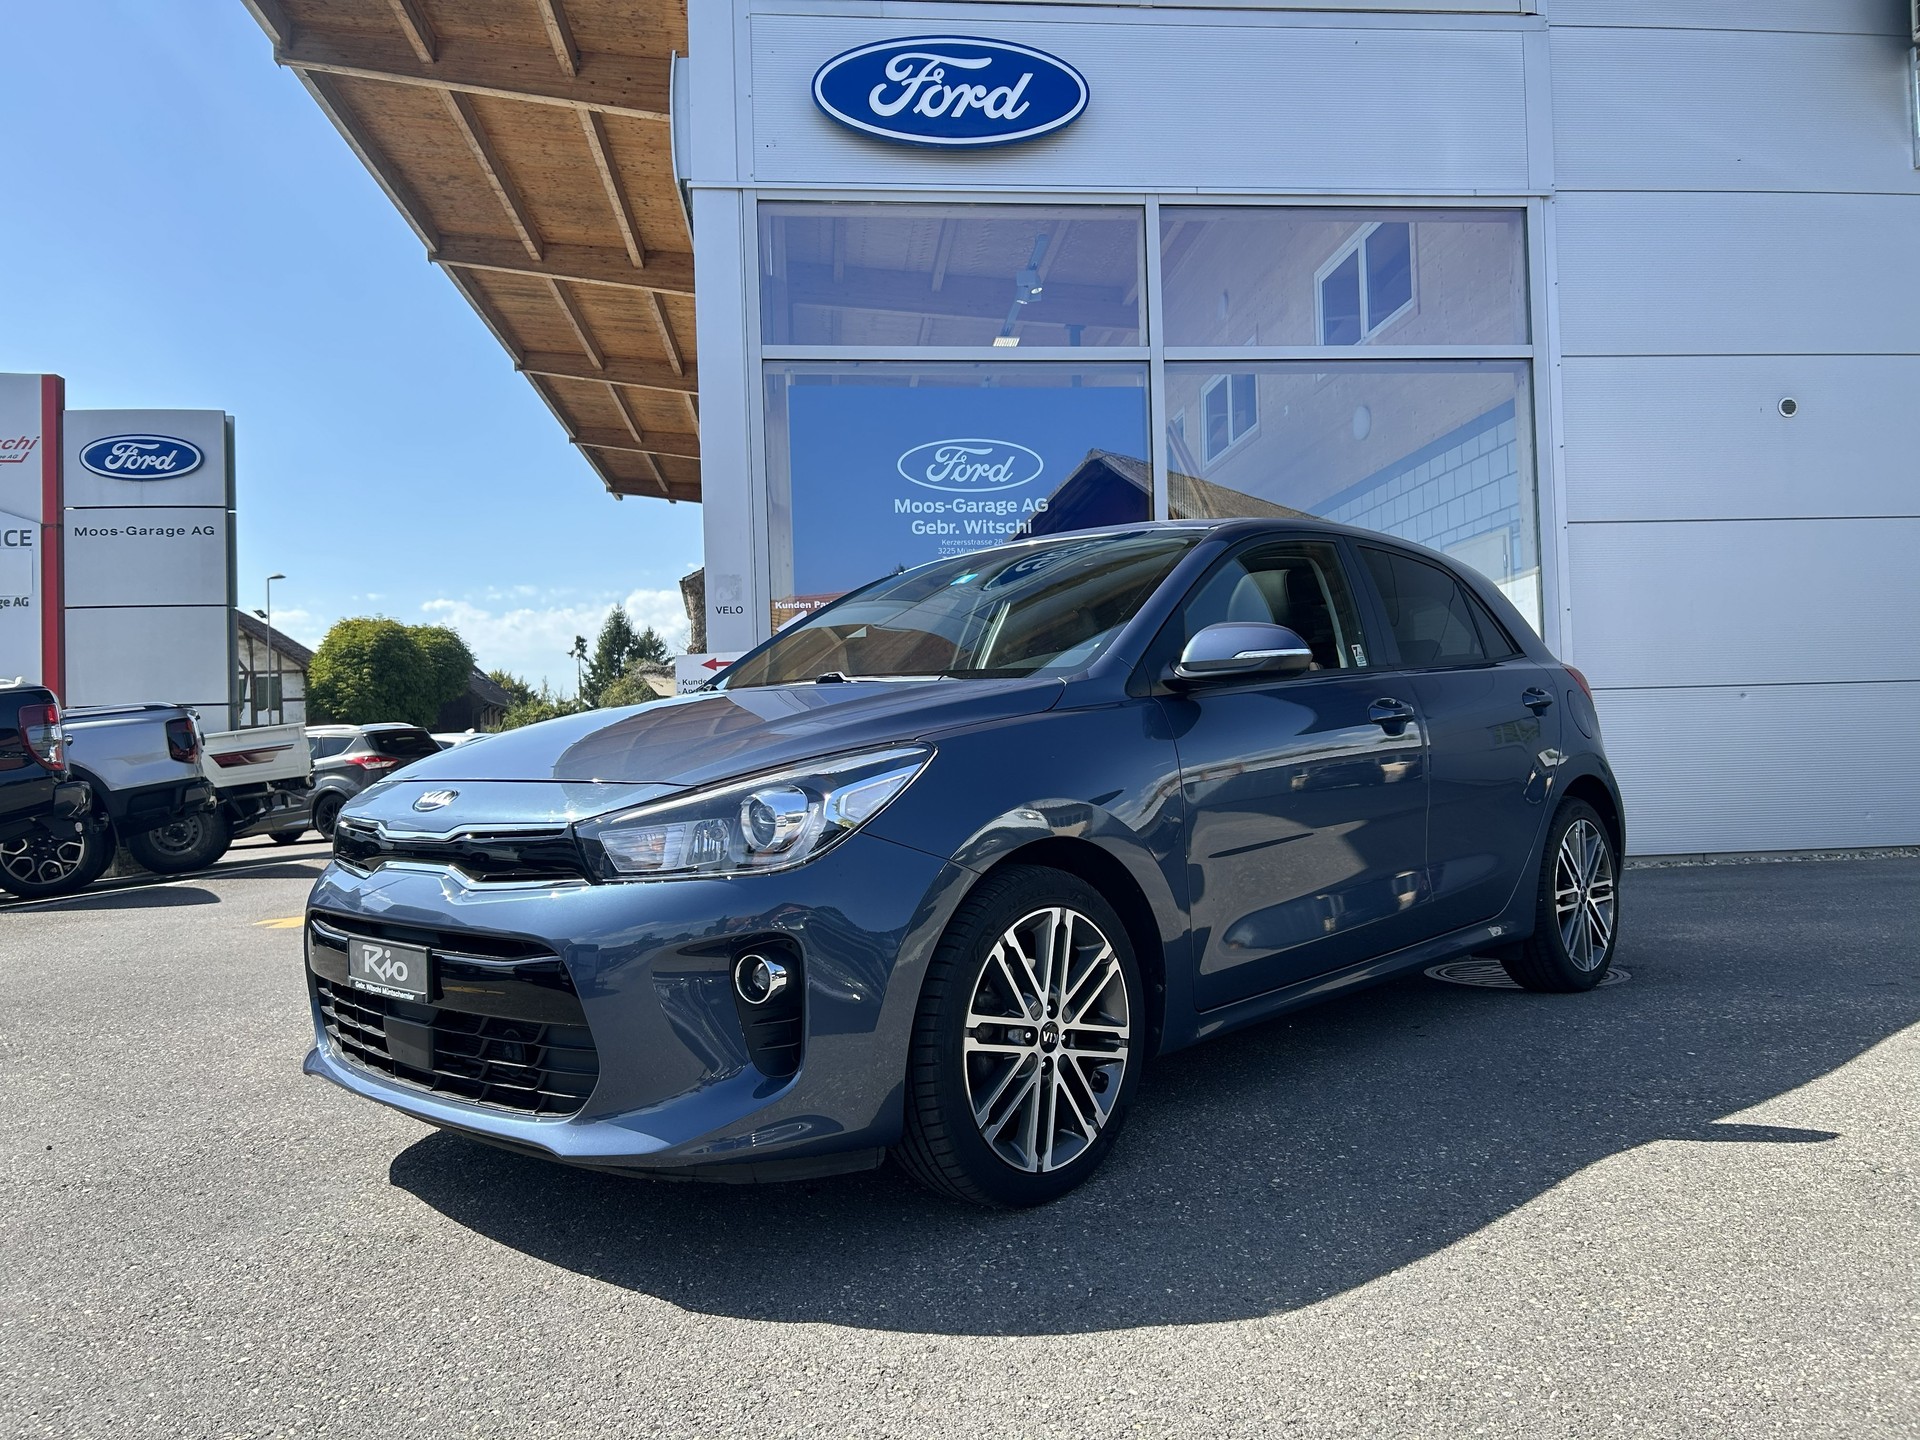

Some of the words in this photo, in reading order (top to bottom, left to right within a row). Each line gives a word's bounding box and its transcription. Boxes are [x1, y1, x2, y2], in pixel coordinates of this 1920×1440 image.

[868, 52, 1033, 120] Ford
[0, 435, 40, 450] chi
[104, 442, 178, 470] Ford
[926, 446, 1016, 482] Ford
[893, 498, 1018, 516] Moos-Garage
[1021, 498, 1049, 513] AG
[74, 526, 186, 538] Moos-Garage
[191, 525, 215, 536] AG
[911, 520, 960, 535] Gebr.
[963, 519, 1033, 535] Witschi
[0, 529, 33, 547] CE
[941, 538, 993, 546] Kerzersstrasse
[937, 547, 956, 555] 3225
[13, 596, 29, 607] AG
[774, 600, 812, 609] Kunden
[715, 605, 744, 615] VELO
[362, 944, 409, 982] Rio
